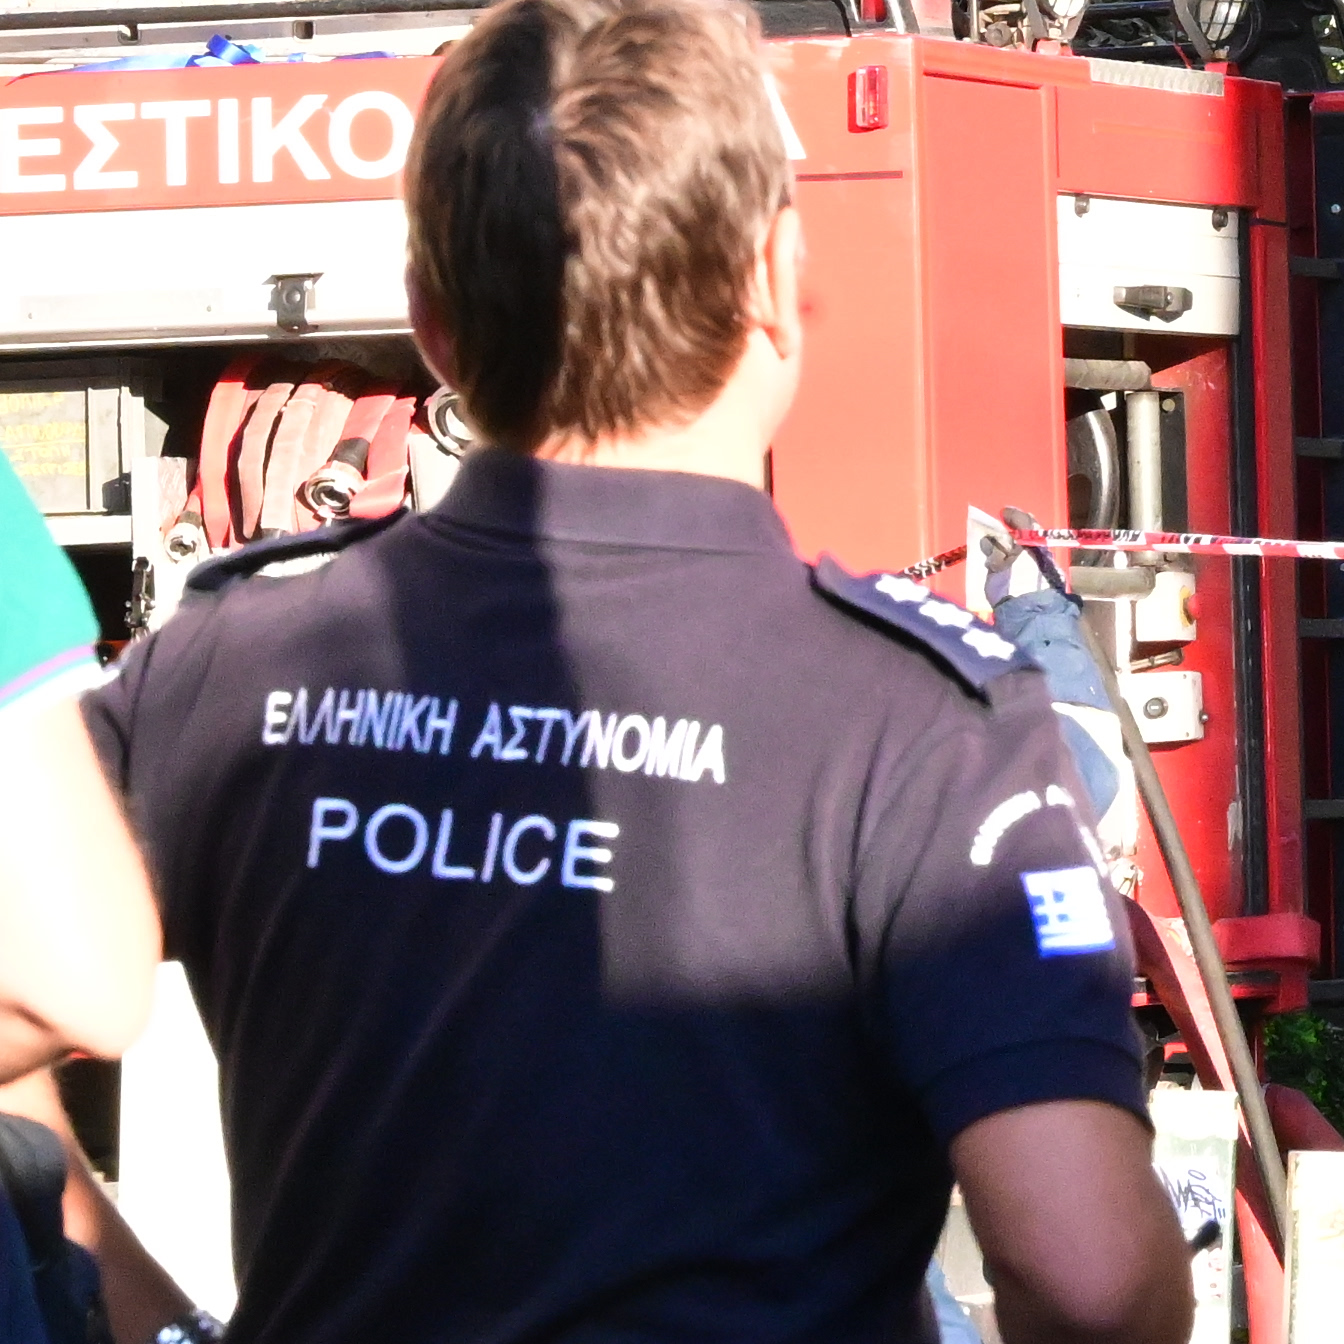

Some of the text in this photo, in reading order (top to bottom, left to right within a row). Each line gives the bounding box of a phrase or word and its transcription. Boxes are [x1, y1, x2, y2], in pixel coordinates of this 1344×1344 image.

[262, 687, 726, 784] ΕΛΛΗΝΙΚΗ ΑΣΤΥΝΟΜΙΑ
[307, 796, 620, 893] POLICE
